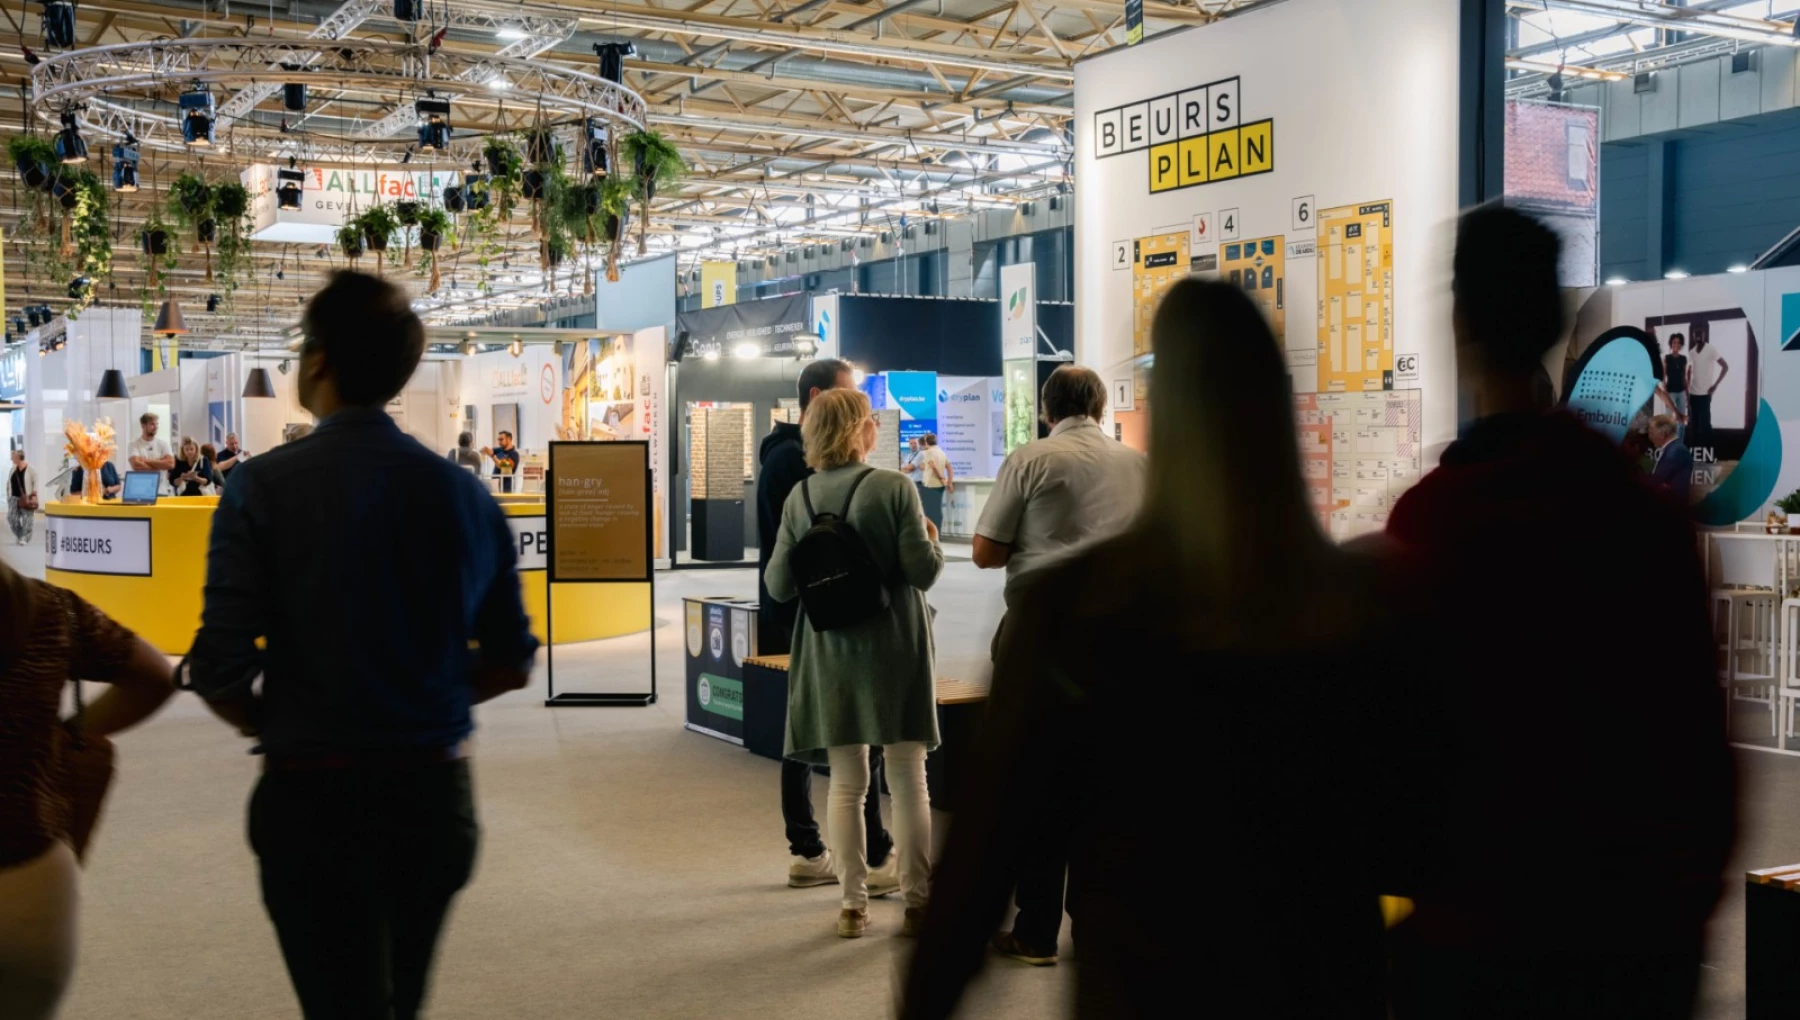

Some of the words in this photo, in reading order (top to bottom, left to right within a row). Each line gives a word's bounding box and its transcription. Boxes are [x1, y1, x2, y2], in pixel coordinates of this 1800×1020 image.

[1101, 92, 1232, 149] BEURS
[1157, 133, 1266, 184] PLAN
[1298, 202, 1309, 222] 6
[1224, 214, 1234, 233] 4
[1117, 246, 1126, 264] 2
[1119, 385, 1125, 403] 1
[1577, 408, 1628, 427] Embuild
[60, 536, 112, 555] #BISBEURS
